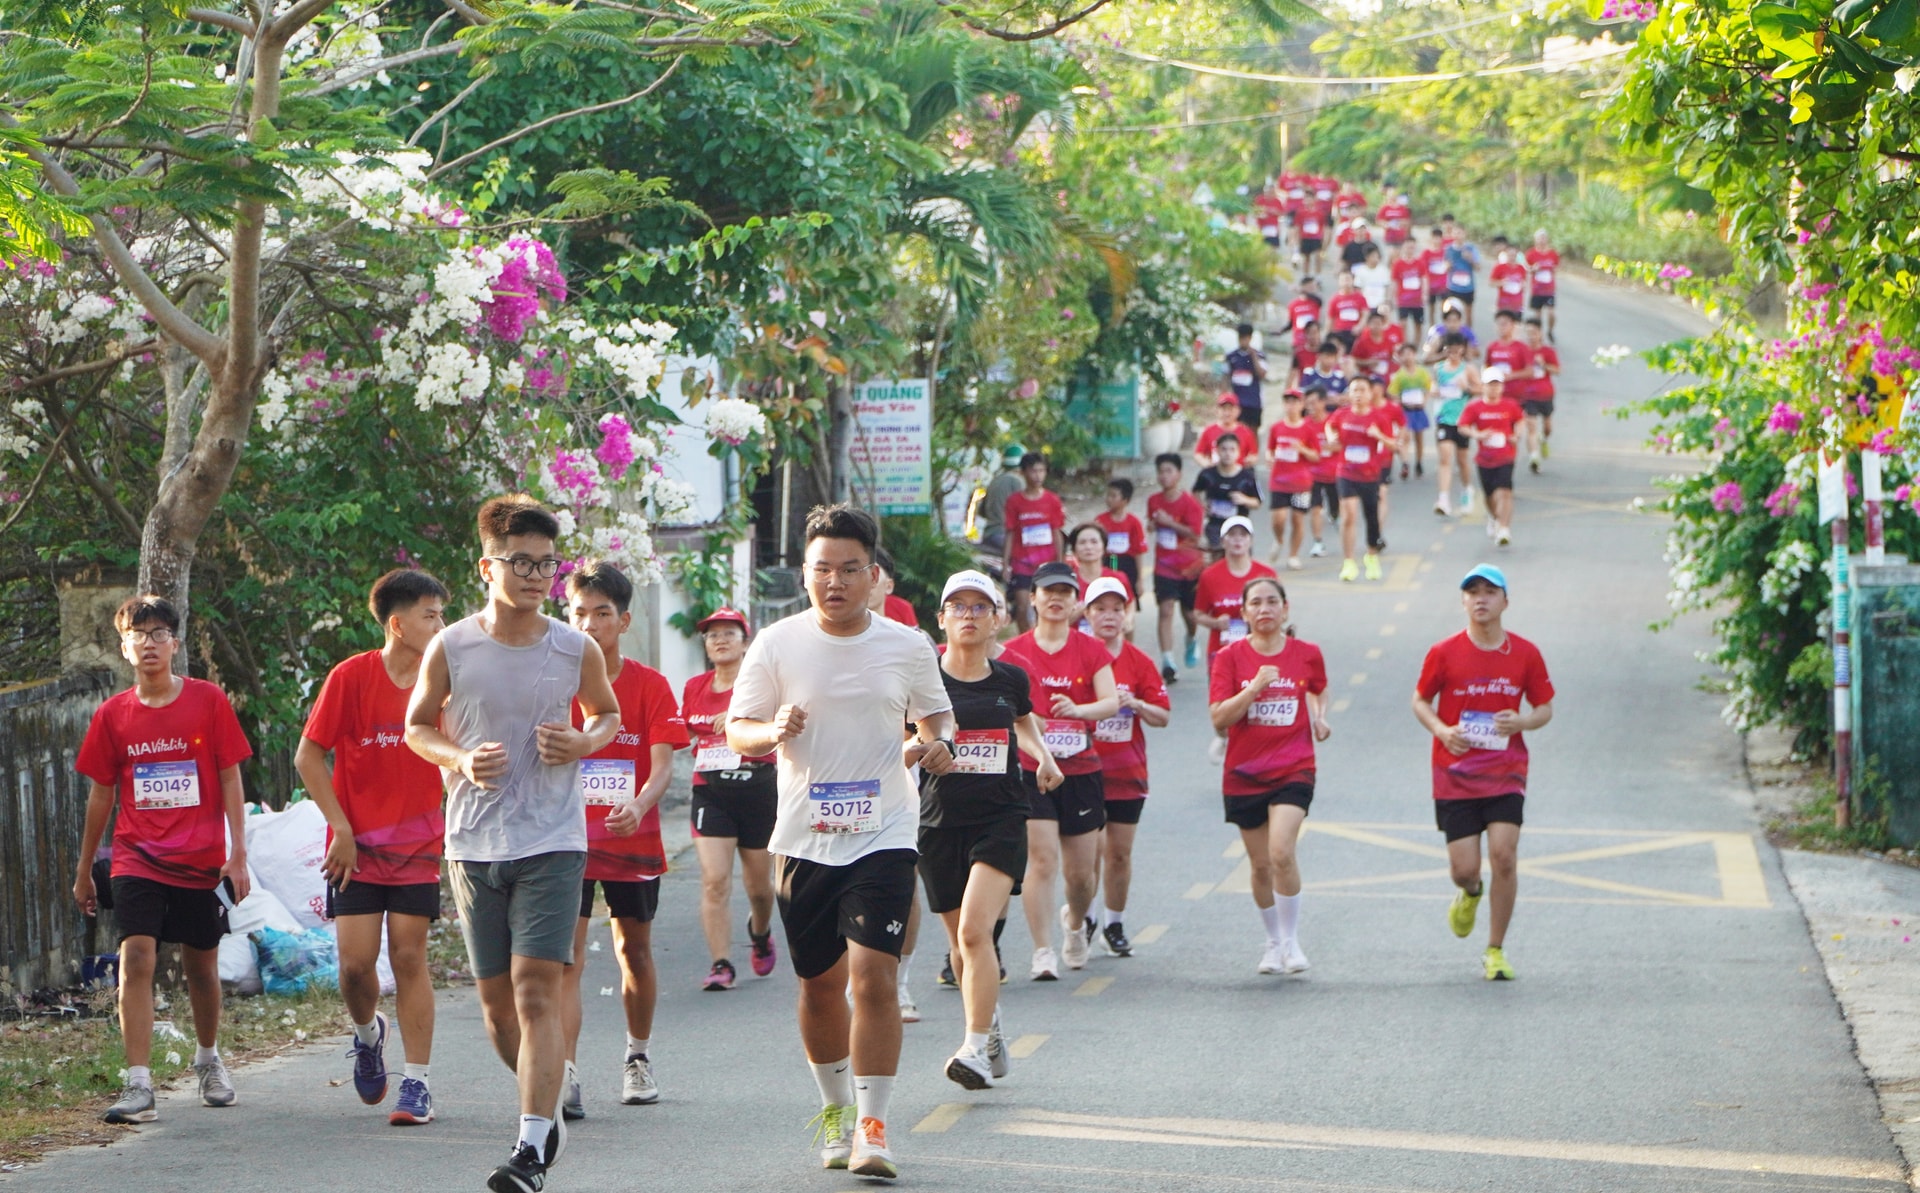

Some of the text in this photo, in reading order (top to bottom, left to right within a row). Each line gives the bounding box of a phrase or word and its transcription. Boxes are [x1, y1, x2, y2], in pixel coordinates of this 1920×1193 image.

[1254, 702, 1294, 716] 10745
[151, 737, 188, 754] Vitality
[374, 732, 401, 749] Ngày
[616, 733, 640, 746] 2026
[142, 778, 193, 794] 50149
[582, 776, 628, 791] 50132
[819, 799, 874, 818] 50712
